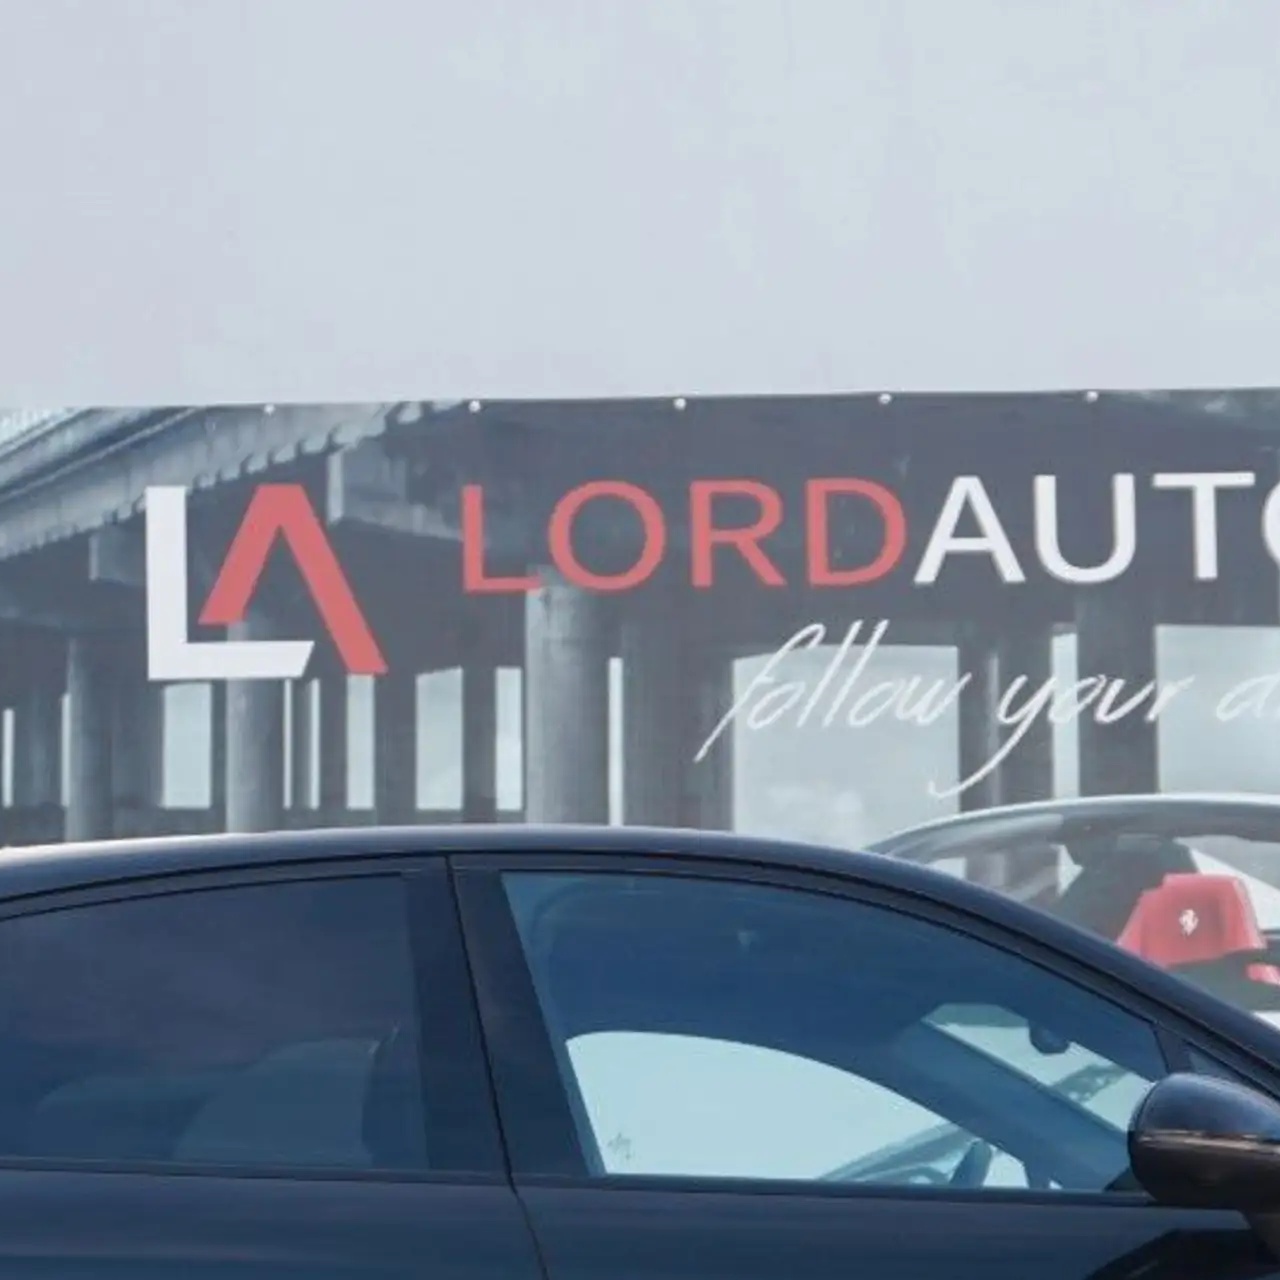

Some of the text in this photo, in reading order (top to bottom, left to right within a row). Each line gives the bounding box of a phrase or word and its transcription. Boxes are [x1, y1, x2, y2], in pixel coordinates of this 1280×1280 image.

[144, 483, 388, 680] LA
[694, 619, 971, 763] follow
[928, 674, 1197, 799] your
